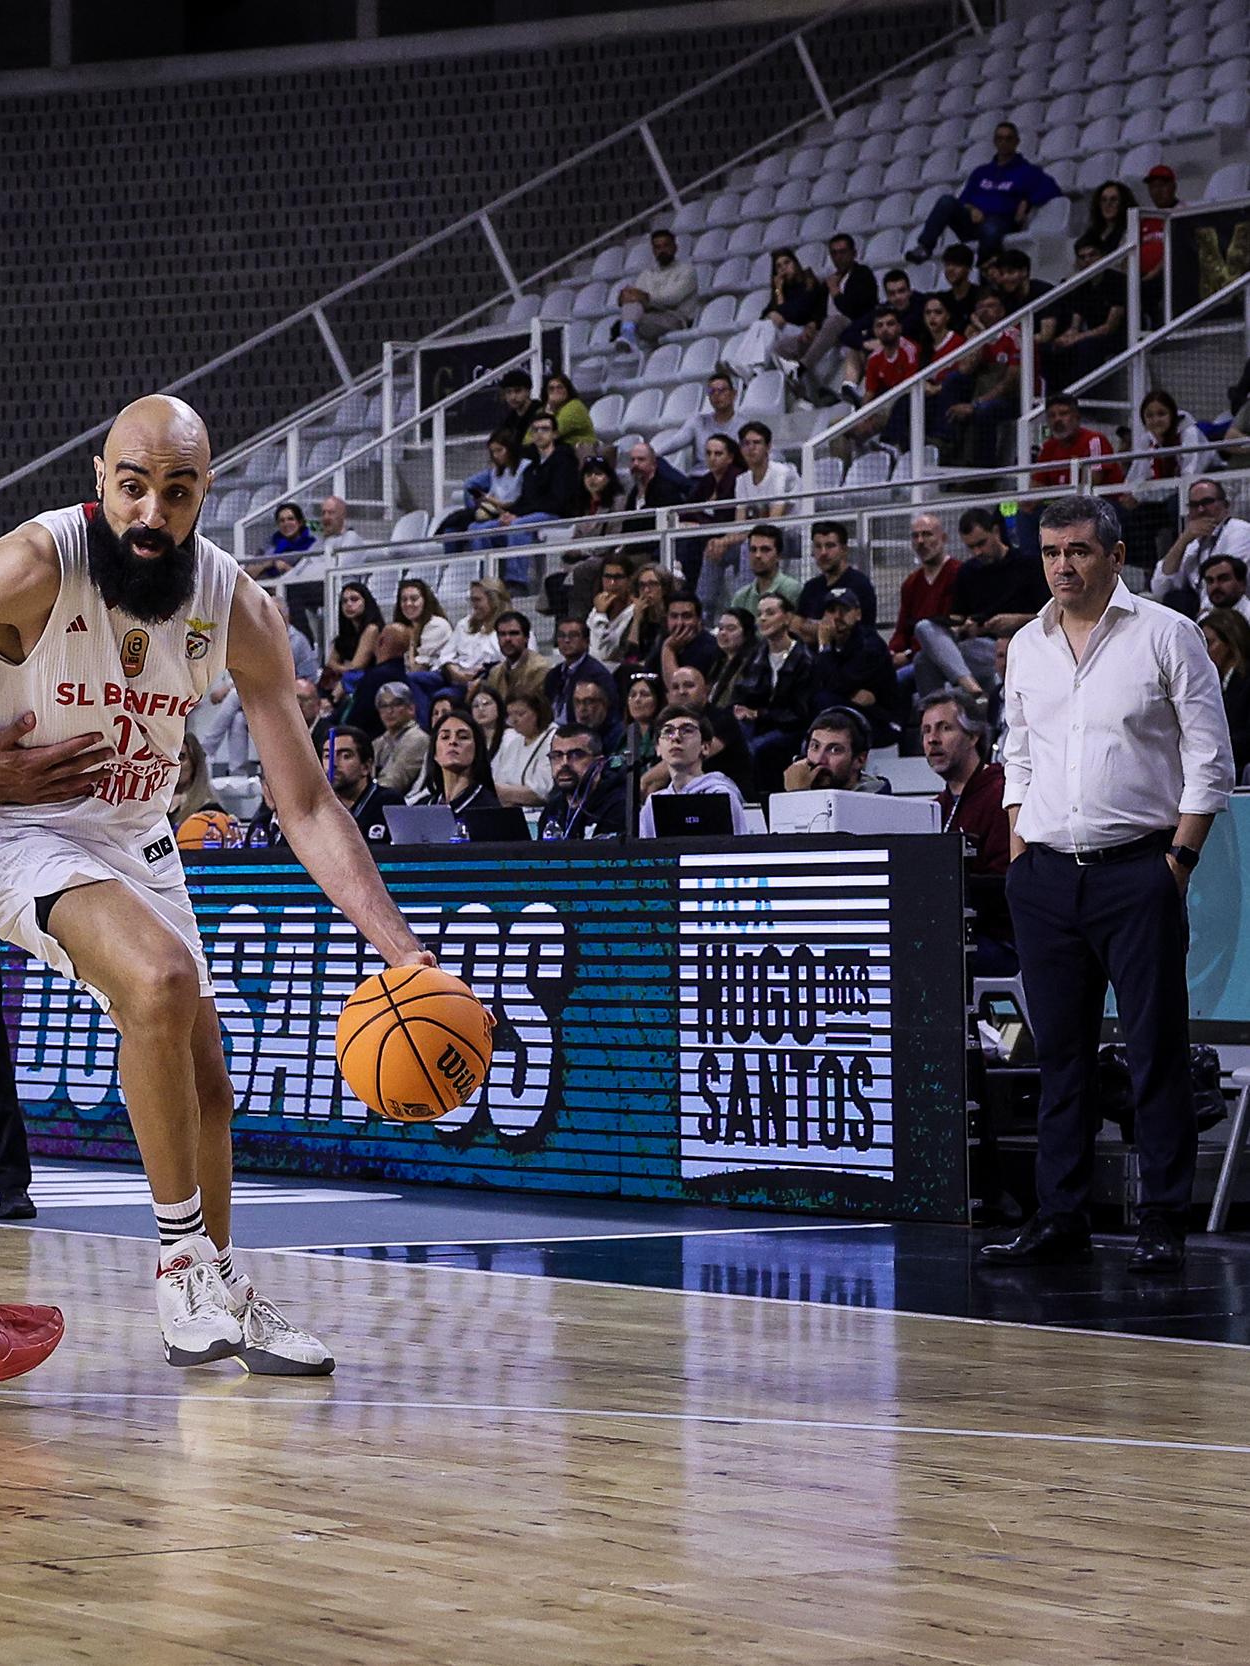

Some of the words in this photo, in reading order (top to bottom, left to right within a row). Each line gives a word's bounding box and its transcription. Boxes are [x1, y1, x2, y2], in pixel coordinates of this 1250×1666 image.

[55, 682, 95, 706] SL
[698, 943, 816, 1047] HUGO
[698, 1051, 875, 1153] SANTOS
